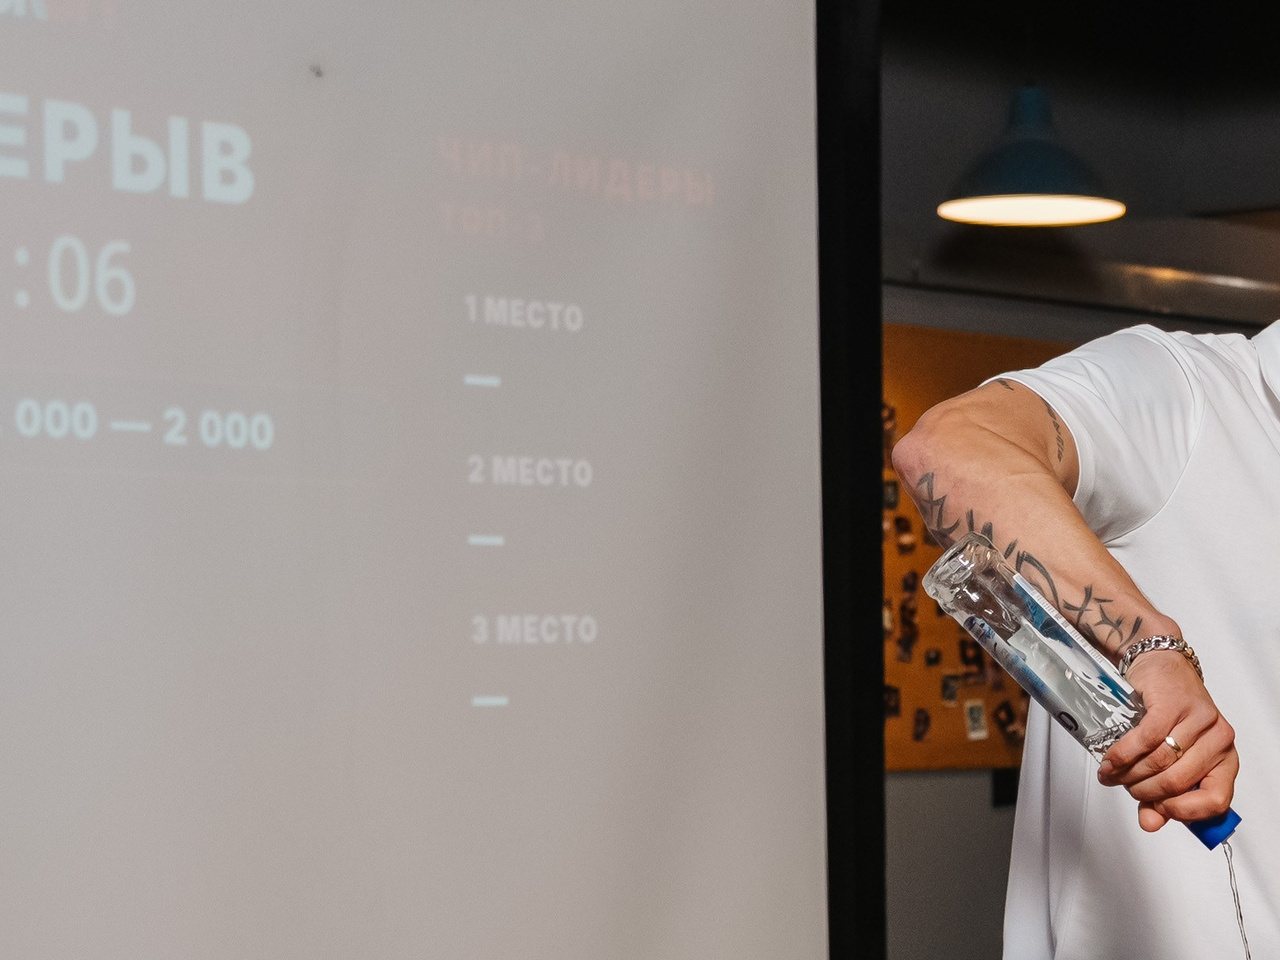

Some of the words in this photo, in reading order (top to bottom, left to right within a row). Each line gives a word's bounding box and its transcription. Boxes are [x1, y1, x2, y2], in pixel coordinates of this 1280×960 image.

[465, 294, 477, 324] 1
[485, 295, 583, 332] МЕСТО
[15, 399, 98, 440] 000
[163, 407, 187, 446] 2
[201, 410, 275, 450] 000
[467, 454, 485, 484] 2
[492, 455, 593, 487] МЕСТО
[471, 614, 488, 644] 3
[496, 614, 598, 644] МЕСТО
